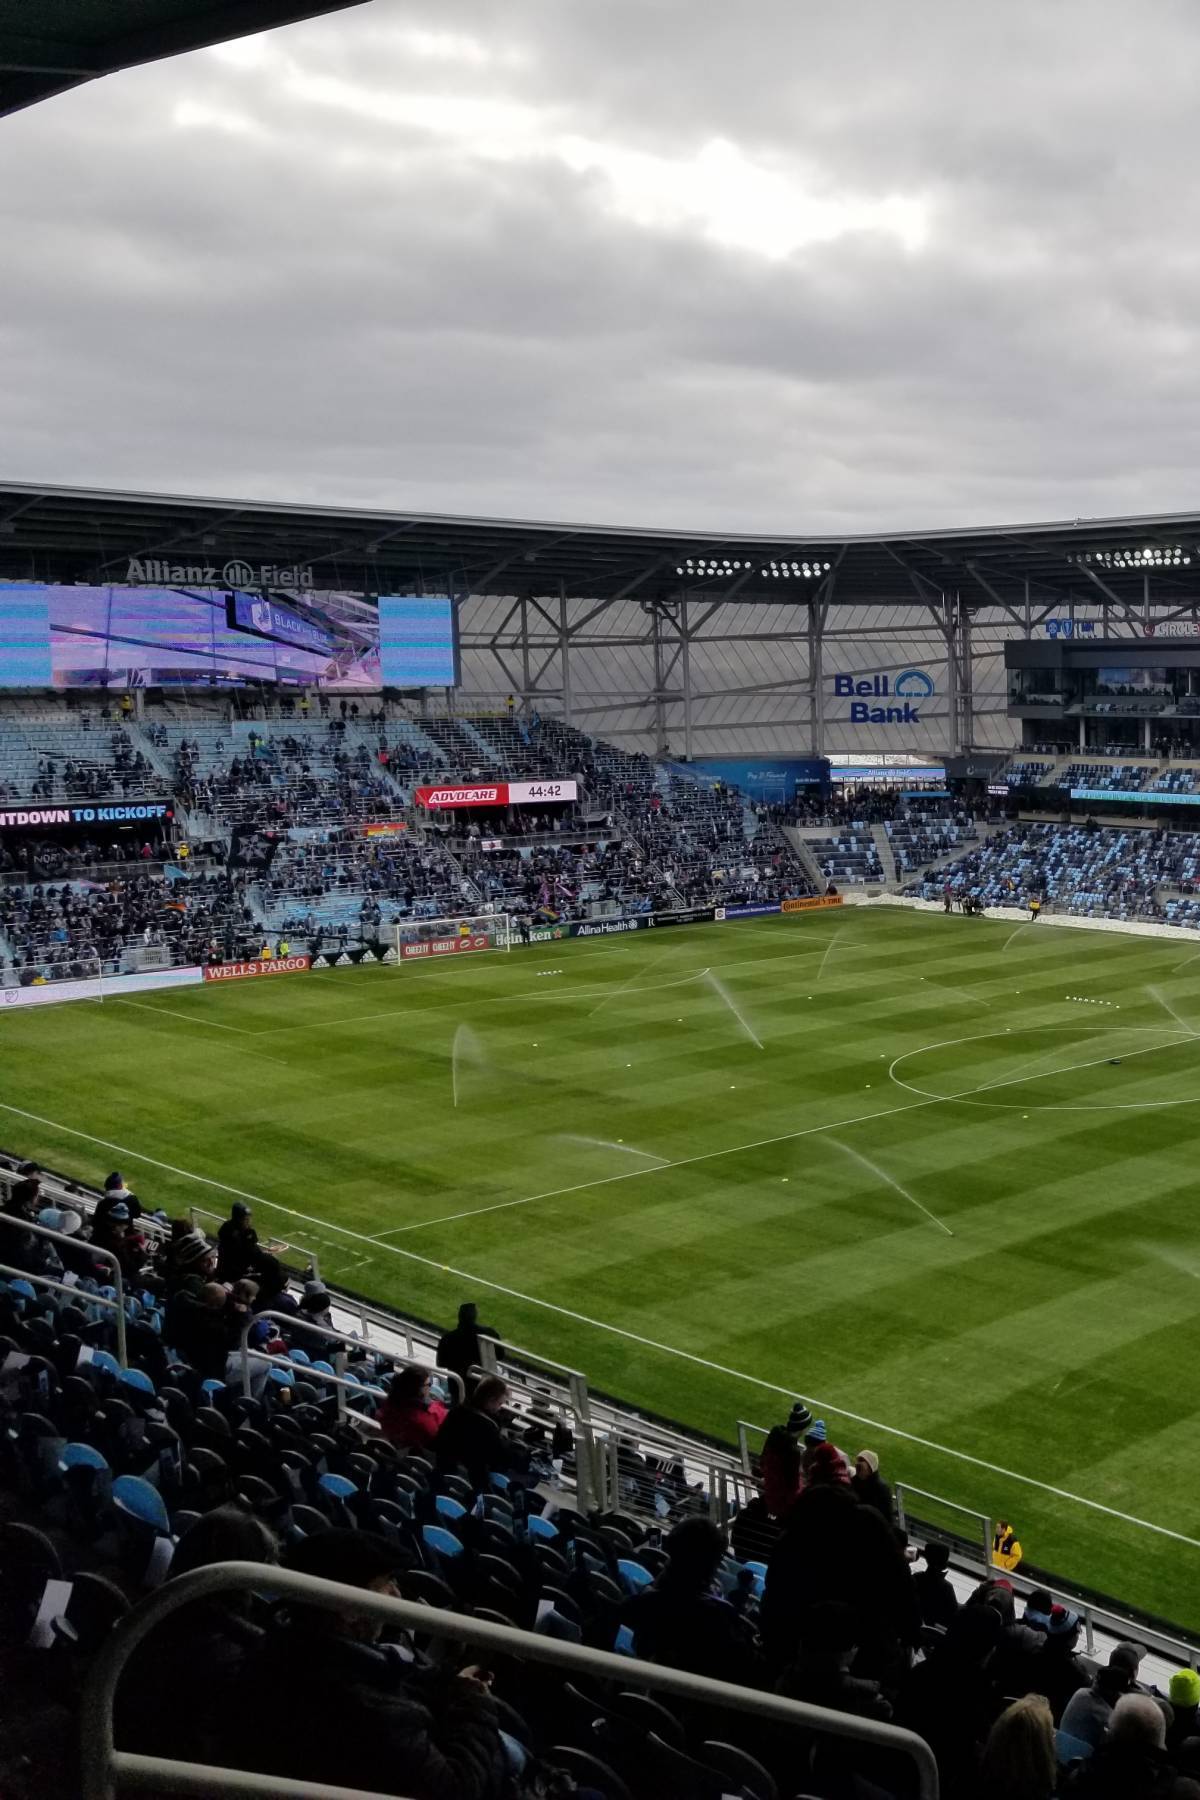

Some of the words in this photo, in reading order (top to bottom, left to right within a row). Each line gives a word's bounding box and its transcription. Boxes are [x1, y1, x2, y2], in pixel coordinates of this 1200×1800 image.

[126, 558, 217, 583] Allianz
[260, 565, 313, 587] Field
[834, 674, 889, 697] Bell
[850, 702, 920, 723] Bank
[429, 789, 497, 804] ADVOCARE
[528, 785, 561, 797] 44:42
[72, 809, 95, 822] TO
[577, 923, 601, 936] Allina
[601, 919, 628, 933] Health
[495, 930, 551, 946] Heinken
[208, 961, 257, 979] WELLS
[260, 957, 307, 974] FARGO
